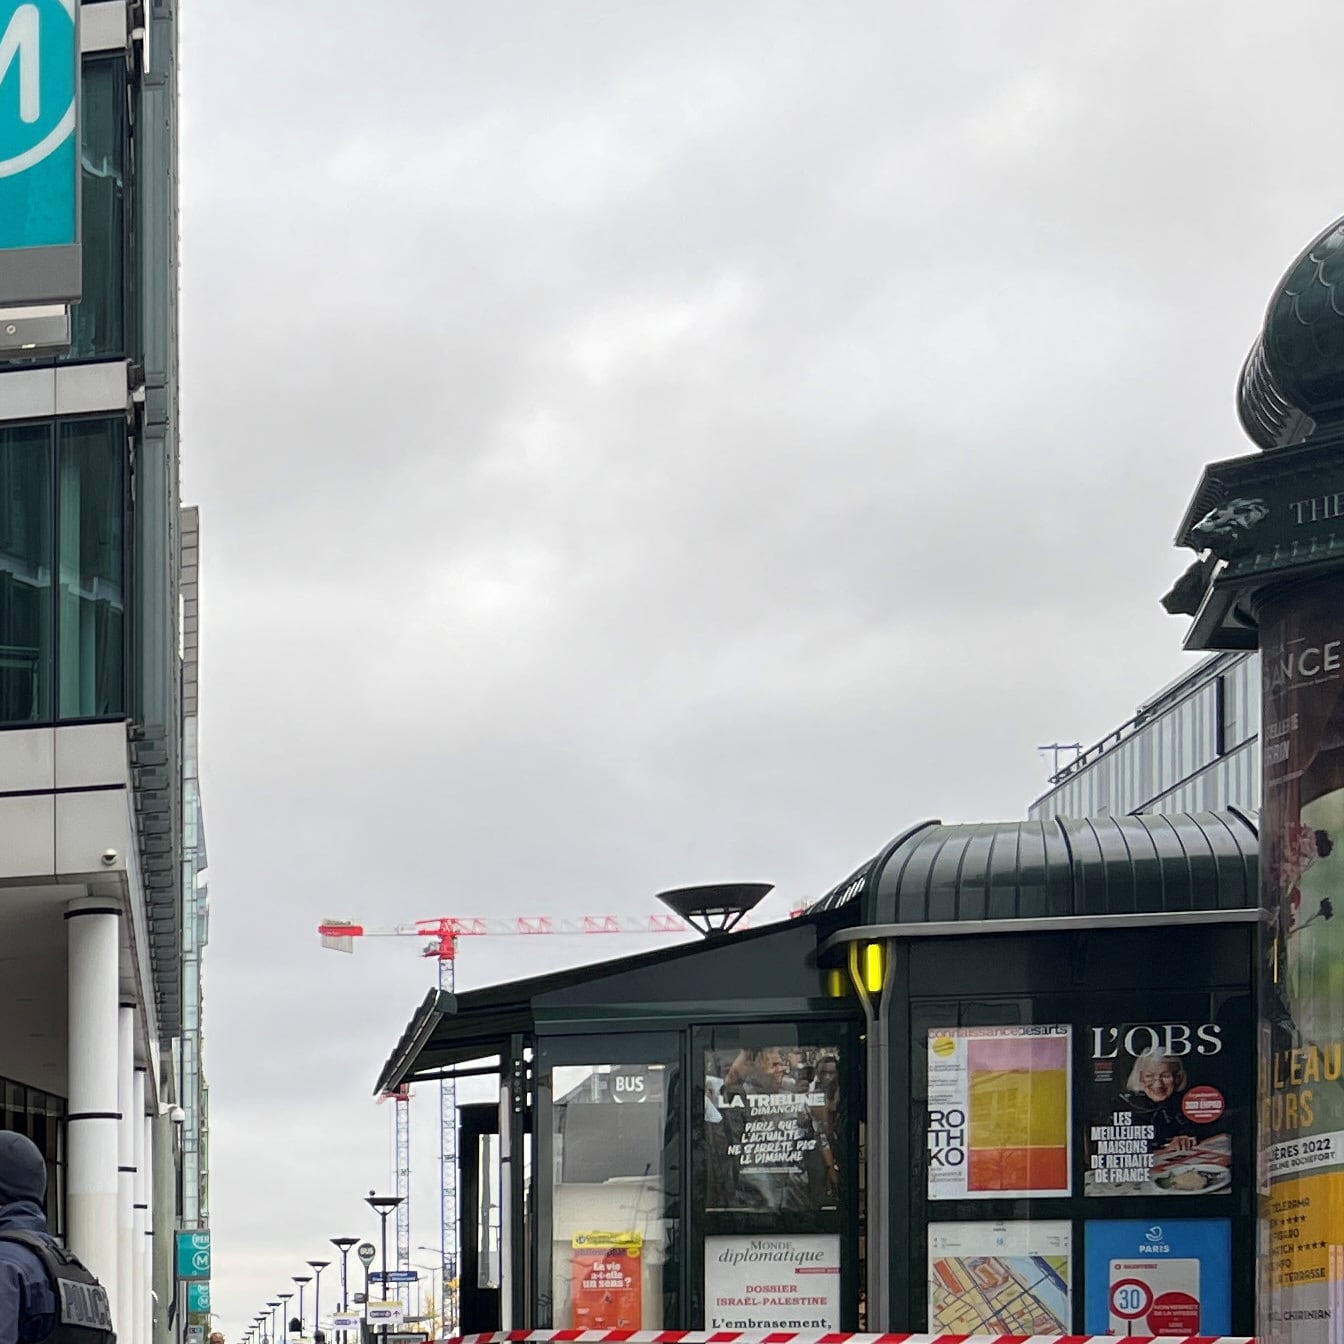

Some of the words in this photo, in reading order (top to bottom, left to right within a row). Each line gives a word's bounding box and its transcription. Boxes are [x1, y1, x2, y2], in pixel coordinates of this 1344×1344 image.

[615, 1076, 645, 1092] BUS
[718, 1094, 745, 1108] LA
[746, 1093, 826, 1107] TRIBUNE
[750, 1104, 805, 1117] DIMANCHE
[928, 1109, 965, 1128] RO
[1113, 1112, 1132, 1126] LES
[928, 1128, 965, 1147] TH
[1091, 1125, 1154, 1141] MEILLEURES
[728, 1144, 742, 1155] NE
[1097, 1140, 1148, 1154] MAISONS
[1302, 1138, 1331, 1155] 2022
[740, 1154, 752, 1165] LE
[754, 1150, 804, 1164] DIMANCHE
[928, 1147, 965, 1166] KO
[1091, 1155, 1105, 1169] DE
[1105, 1153, 1154, 1169] RETRAITE
[1095, 1168, 1109, 1183] DE
[1110, 1167, 1150, 1182] FRANCE
[360, 1247, 374, 1255] BUS
[1139, 1245, 1170, 1253] PARIS
[196, 1255, 208, 1266] M
[718, 1248, 824, 1266] diplomatique
[593, 1262, 605, 1271] La
[606, 1262, 621, 1271] vie
[583, 1280, 597, 1288] un
[598, 1280, 624, 1288] sens
[624, 1277, 632, 1288] ?
[746, 1285, 798, 1294] DOSSIER
[716, 1296, 828, 1307] ISRAËL-PALESTINE
[1119, 1288, 1141, 1310] 30
[712, 1318, 832, 1330] L'embrasement,
